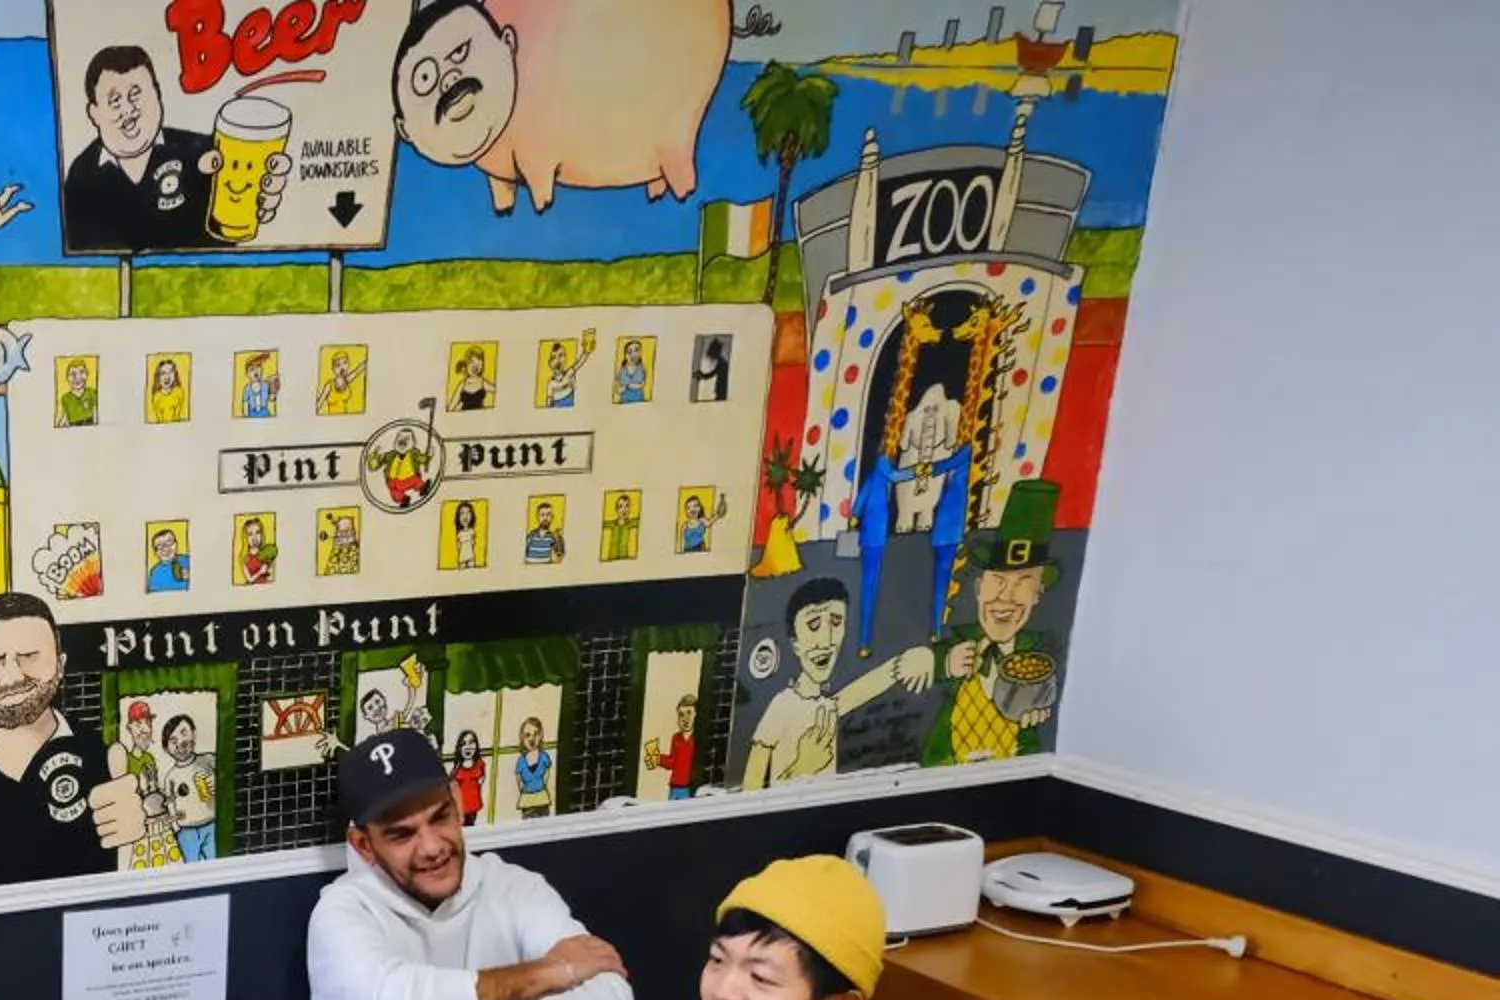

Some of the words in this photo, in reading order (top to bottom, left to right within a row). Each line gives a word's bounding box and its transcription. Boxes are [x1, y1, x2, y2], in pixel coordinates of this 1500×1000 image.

[165, 0, 367, 94] Beer
[301, 138, 372, 159] AVAILABLE
[300, 160, 380, 181] DOWNSTAIRS
[886, 175, 993, 262] ZOO
[243, 450, 341, 485] Pint
[46, 537, 96, 585] BOOM
[100, 619, 221, 667] Pint
[243, 620, 296, 650] on
[312, 602, 442, 647] Punt
[370, 743, 395, 775] P
